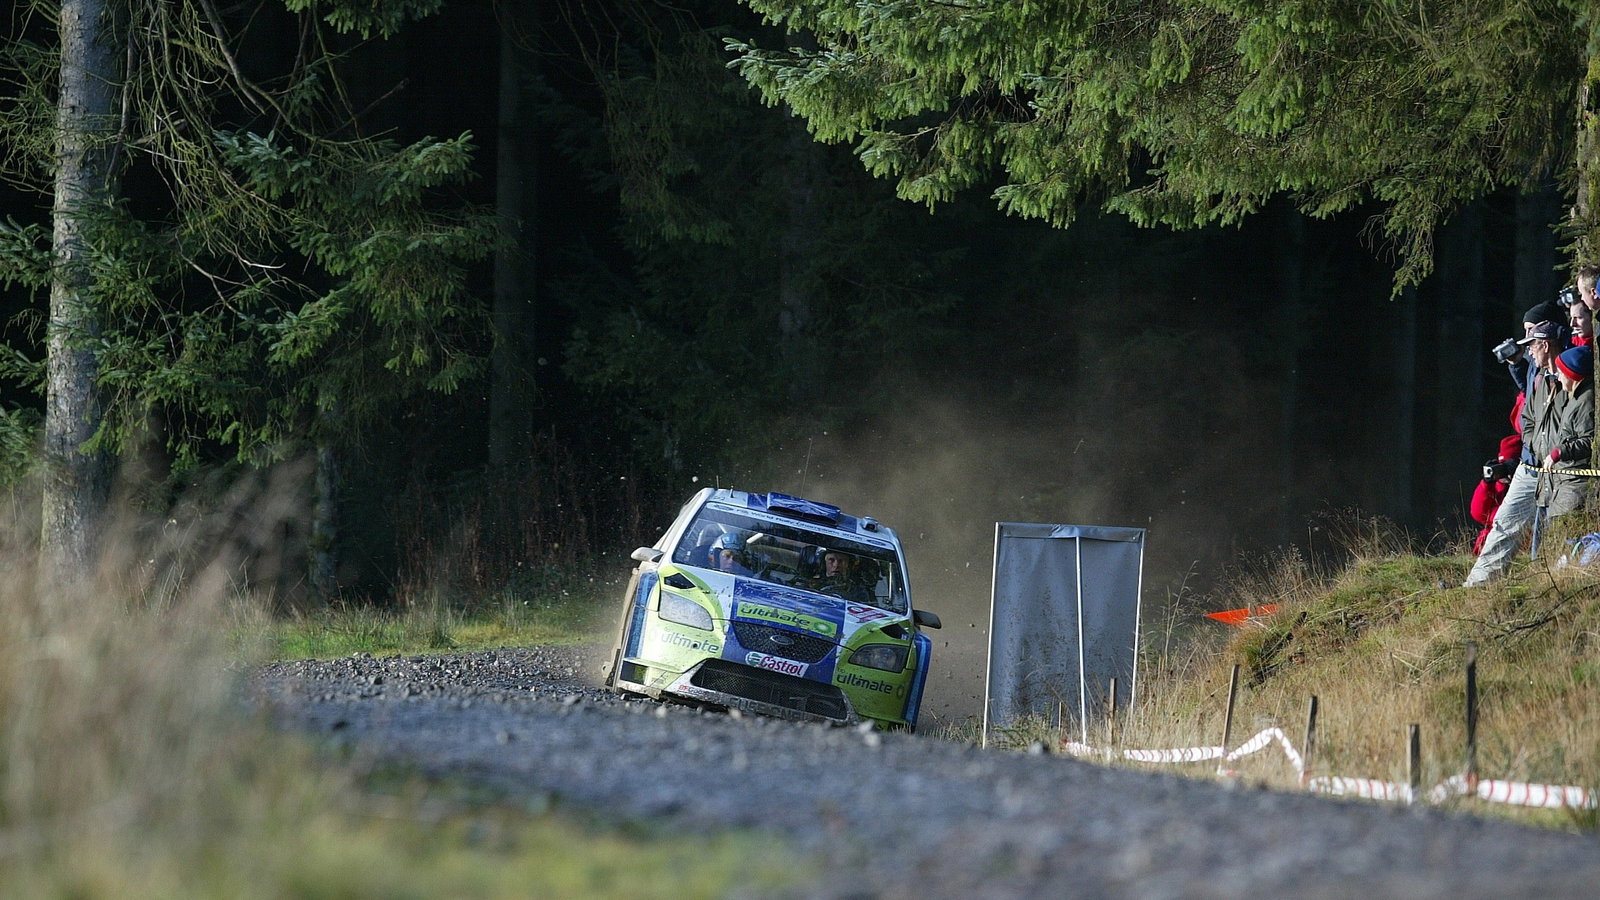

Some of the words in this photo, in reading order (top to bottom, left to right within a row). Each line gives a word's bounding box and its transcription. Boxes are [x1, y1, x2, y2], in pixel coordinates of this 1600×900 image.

[661, 632, 719, 654] ultimate
[760, 656, 804, 676] Castrol
[836, 673, 893, 694] ultimate
